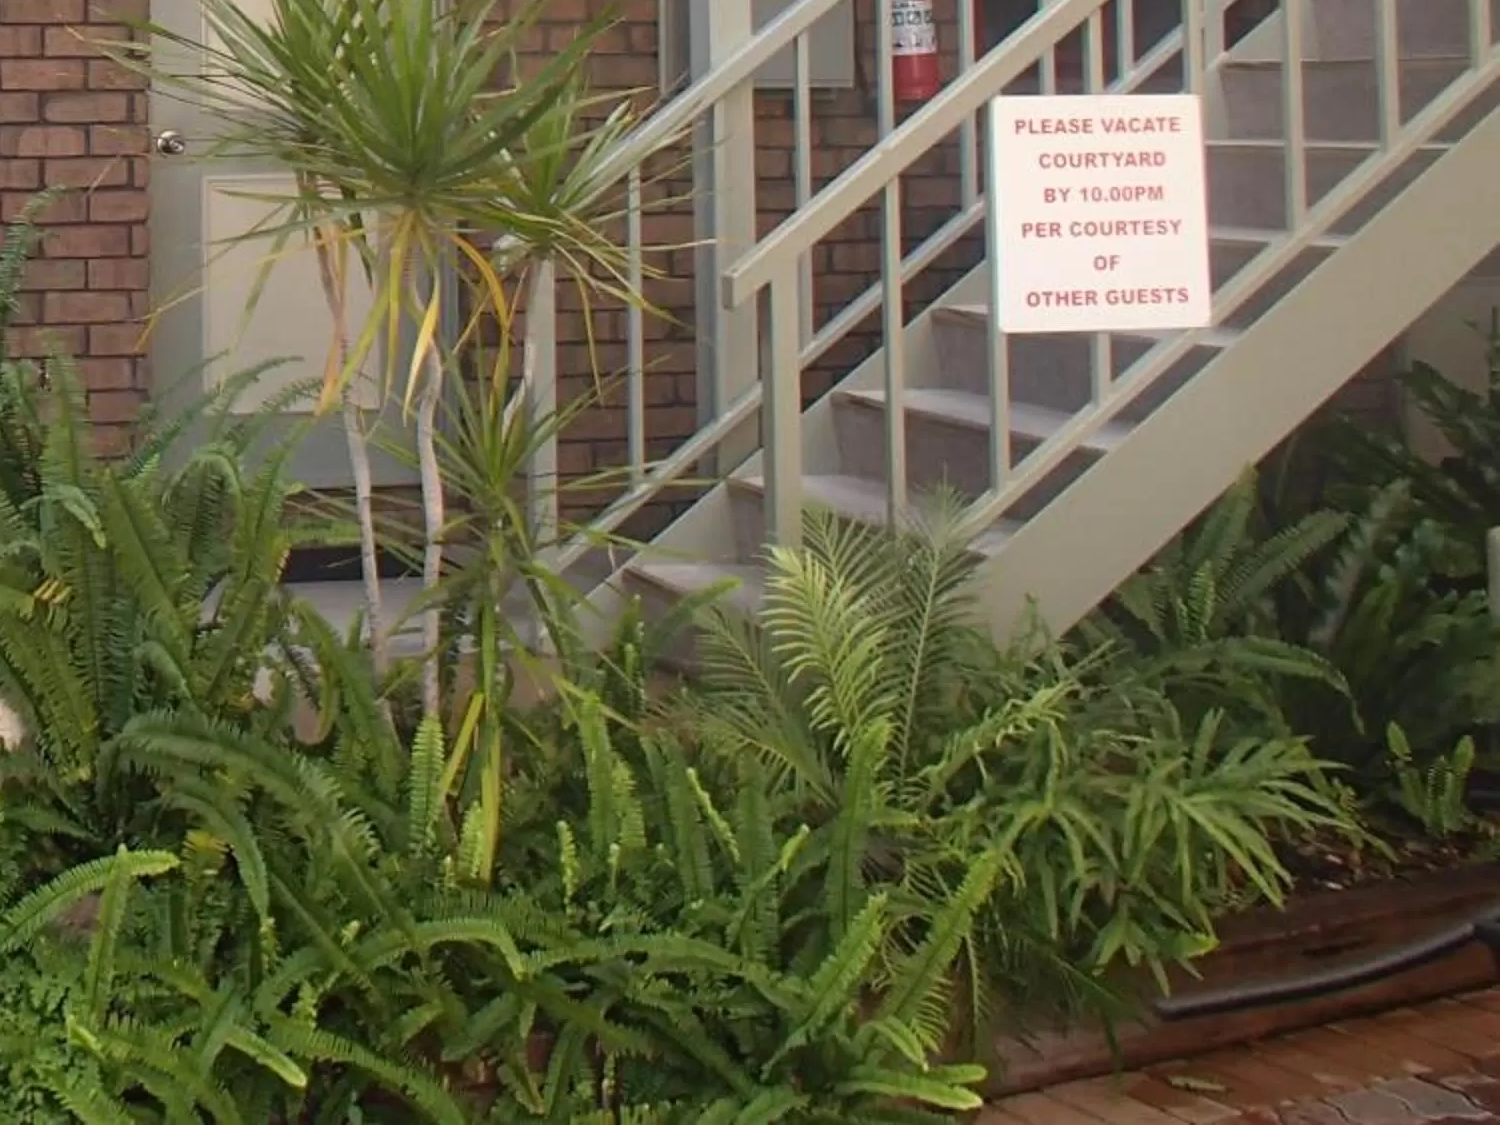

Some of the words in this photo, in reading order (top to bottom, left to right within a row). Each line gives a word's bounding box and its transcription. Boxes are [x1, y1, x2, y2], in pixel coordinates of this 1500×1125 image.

[1014, 118, 1093, 135] PLEASE
[1100, 116, 1181, 134] VACATE
[1038, 151, 1166, 170] COURTYARD
[1043, 187, 1071, 204] BY
[1079, 185, 1164, 203] 10.00PM
[1021, 222, 1062, 239] PER
[1069, 219, 1182, 238] COURTESY
[1093, 254, 1120, 272] OF
[1026, 290, 1098, 308] OTHER
[1104, 287, 1189, 306] GUESTS
